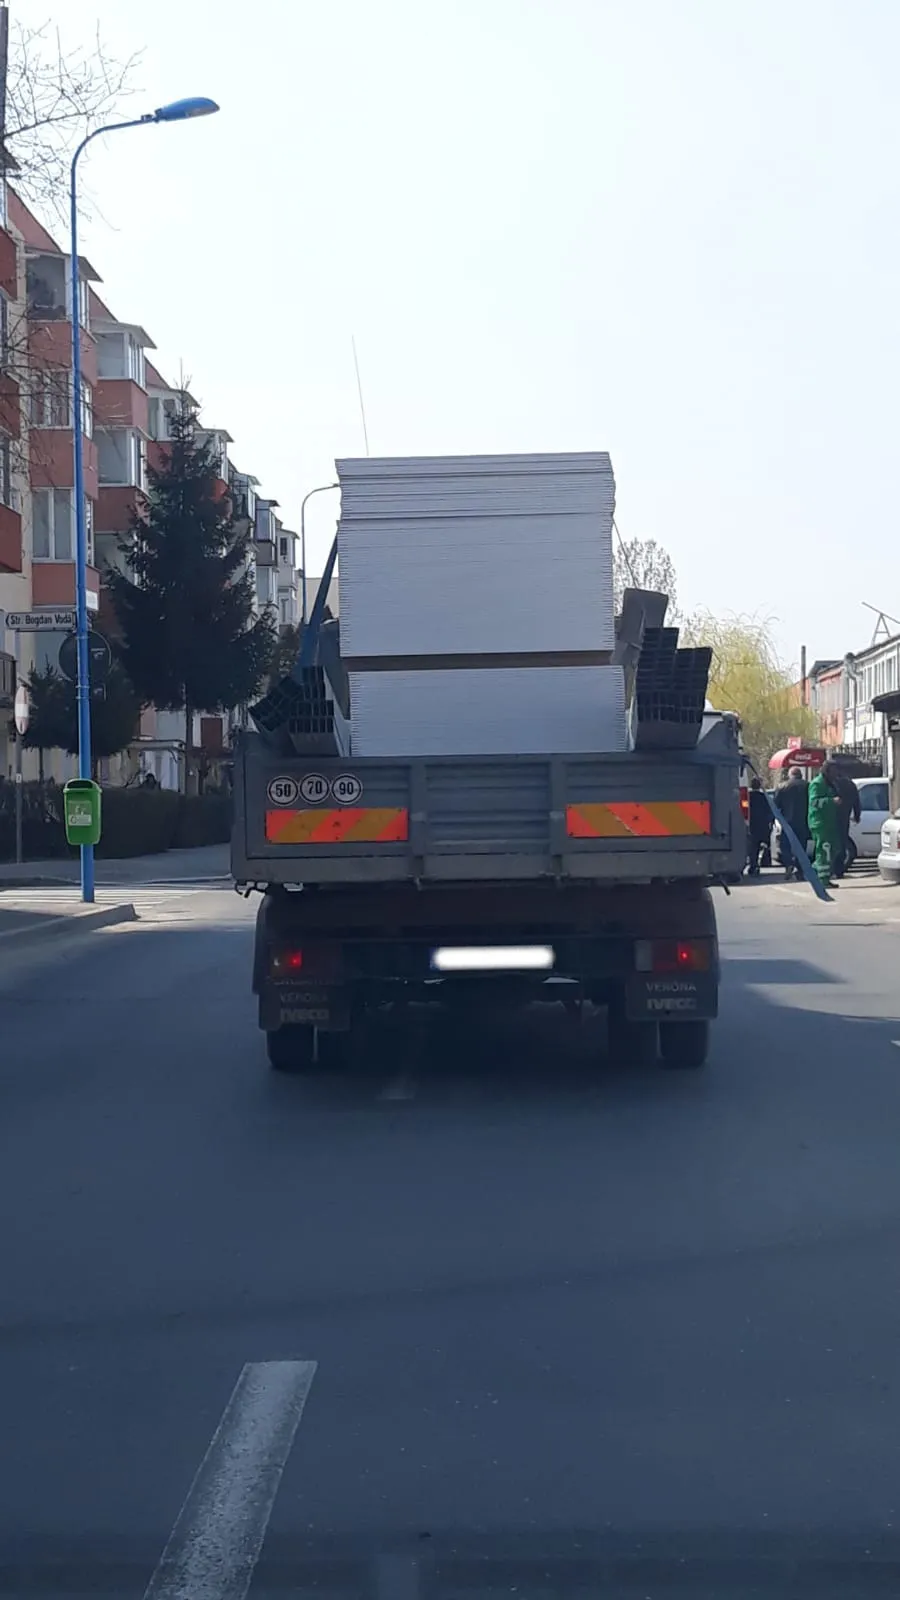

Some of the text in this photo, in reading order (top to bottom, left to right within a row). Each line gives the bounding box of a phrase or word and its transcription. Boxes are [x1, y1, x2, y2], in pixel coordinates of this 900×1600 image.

[25, 614, 53, 627] Bogdan
[275, 783, 292, 798] 50
[307, 780, 323, 795] 70
[338, 781, 354, 796] 90
[645, 981, 697, 994] VERONA
